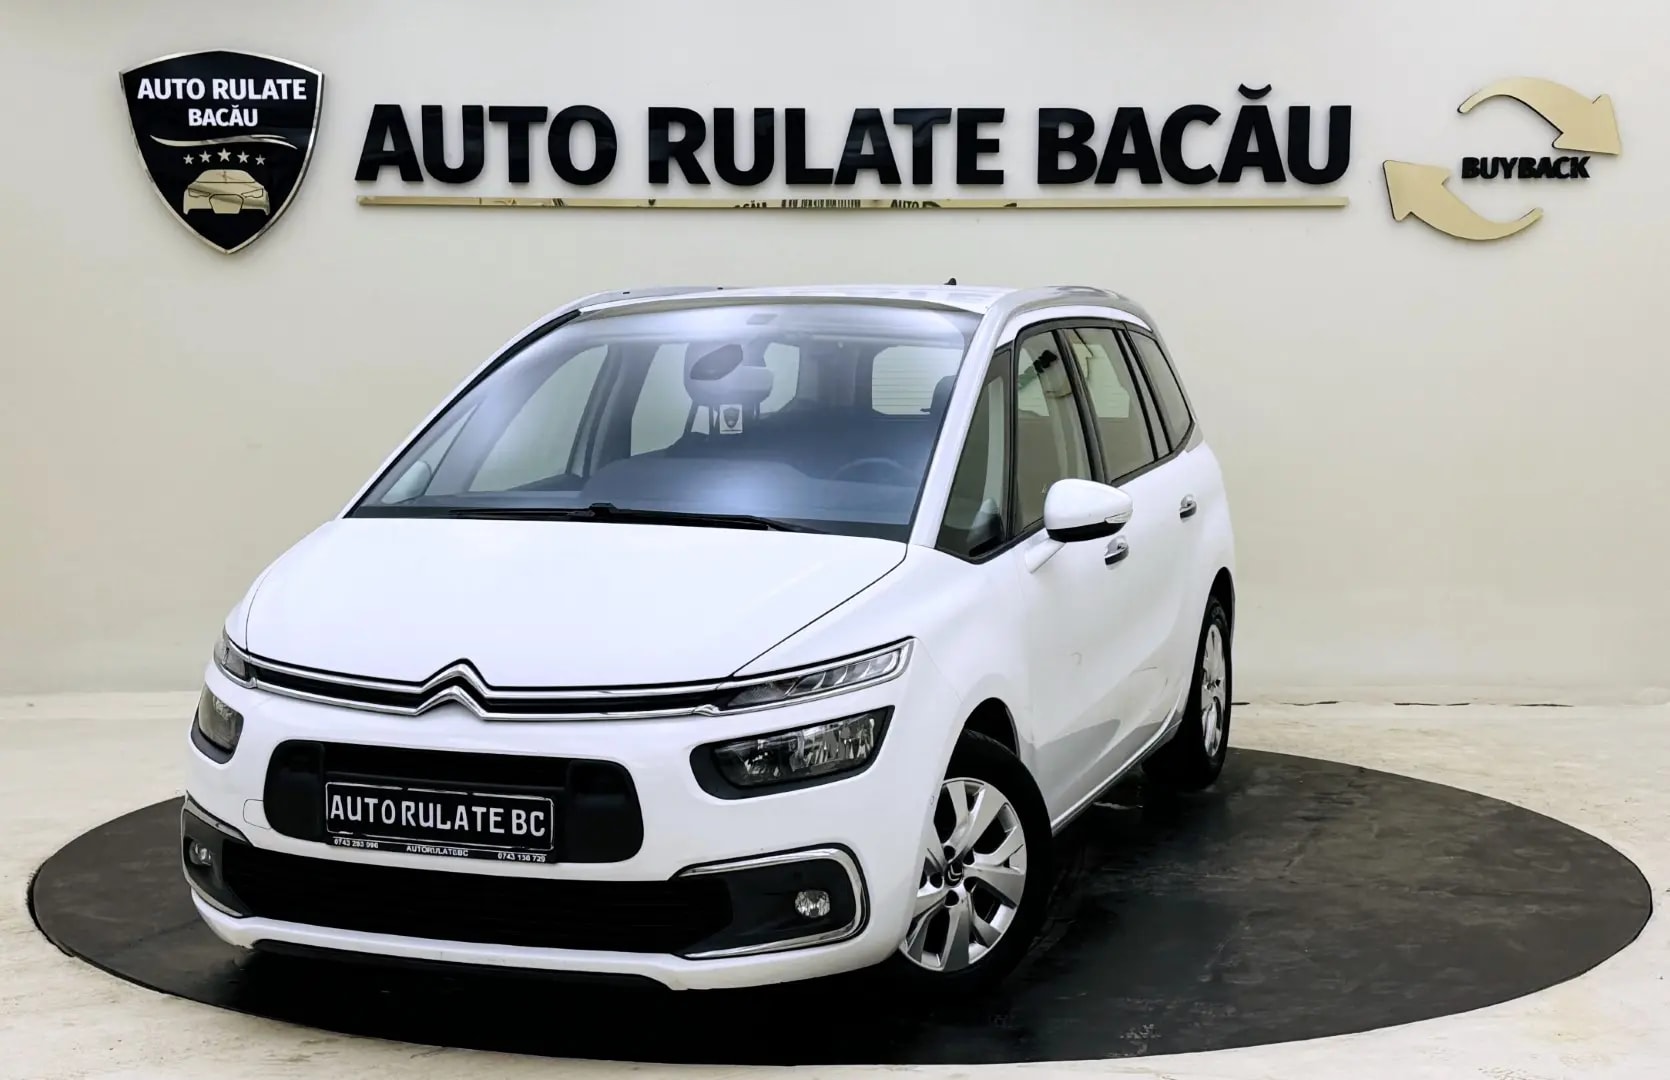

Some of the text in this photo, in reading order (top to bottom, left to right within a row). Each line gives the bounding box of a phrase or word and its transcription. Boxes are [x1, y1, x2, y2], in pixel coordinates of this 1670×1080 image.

[137, 77, 307, 100] AUTO RULATE
[188, 104, 258, 127] BACĂU
[354, 82, 1352, 186] AUTO RULATE BACĂU
[1461, 155, 1590, 180] BUYBACK
[330, 794, 546, 838] AUTO RULATE BC
